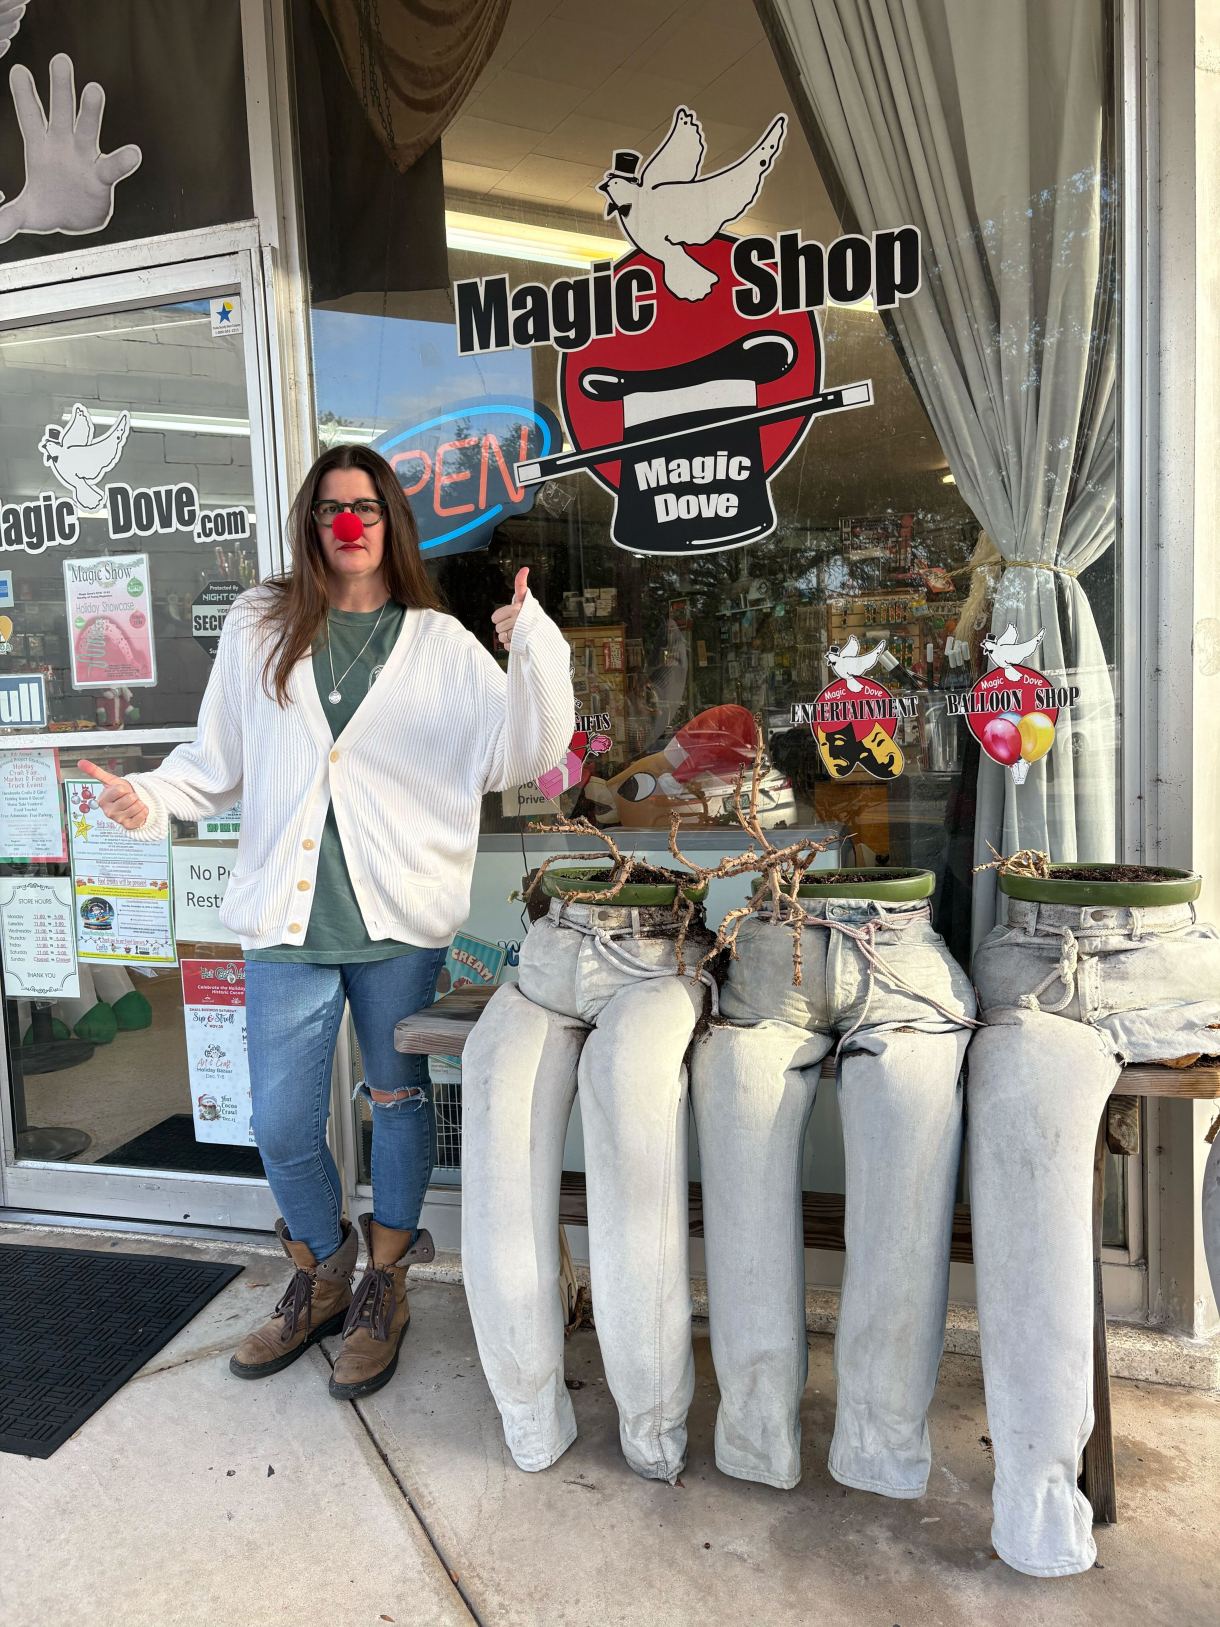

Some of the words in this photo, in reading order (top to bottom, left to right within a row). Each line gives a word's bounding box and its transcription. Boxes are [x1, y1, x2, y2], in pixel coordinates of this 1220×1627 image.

[456, 260, 657, 353] Magic
[732, 225, 921, 316] Shop
[389, 425, 529, 517] PEN
[634, 450, 752, 492] Magic
[653, 491, 740, 523] Dove
[0, 495, 77, 551] agic
[71, 565, 102, 585] Magic
[104, 562, 132, 580] Show
[75, 602, 100, 615] Holiday
[101, 600, 135, 612] Showcase
[202, 593, 228, 601] NIGHT
[193, 615, 226, 631] SECU
[824, 687, 847, 701] Magic
[864, 685, 883, 697] Dove
[980, 676, 1005, 690] Magic
[1023, 674, 1043, 686] Dove
[0, 682, 42, 723] ull
[790, 696, 919, 724] ENTERTAINMENT
[946, 688, 1023, 715] BALLOON
[1034, 686, 1080, 711] SHOP
[518, 794, 545, 804] Drive
[190, 864, 212, 881] No
[451, 948, 495, 983] CREAM
[497, 939, 524, 968] IC
[192, 1011, 206, 1024] Sip
